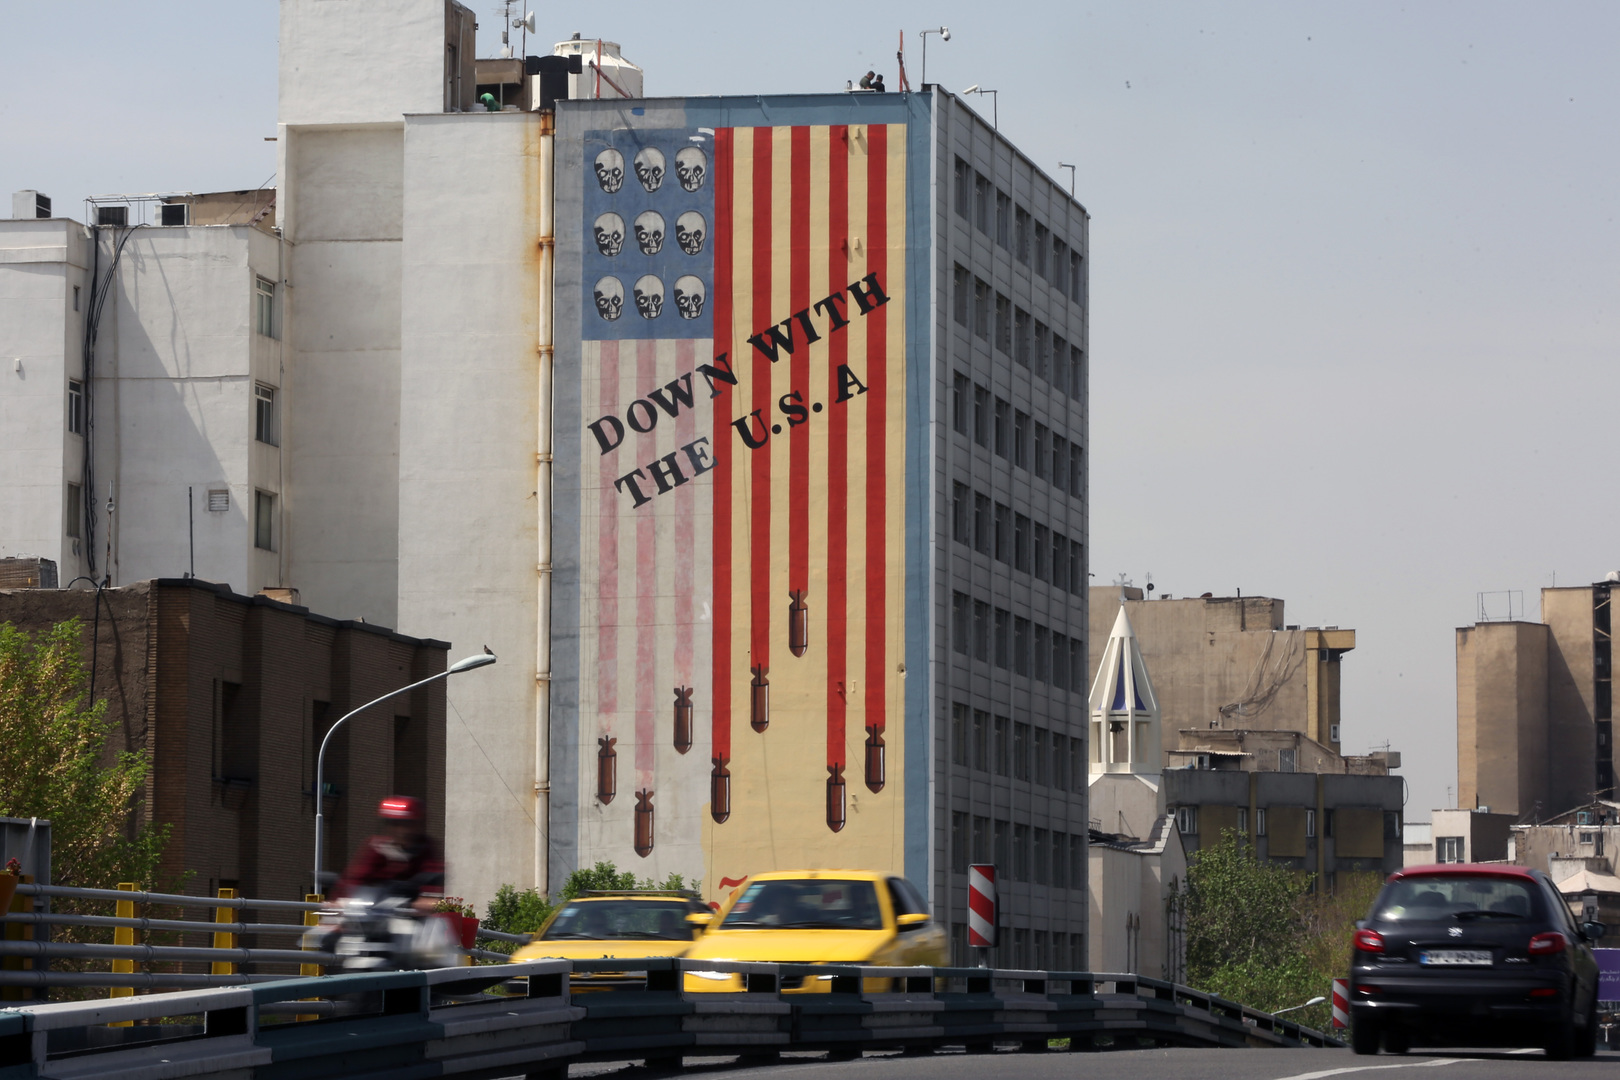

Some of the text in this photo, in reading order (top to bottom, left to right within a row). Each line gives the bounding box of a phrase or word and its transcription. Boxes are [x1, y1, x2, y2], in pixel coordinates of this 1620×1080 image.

[587, 271, 891, 456] DOWN WITH
[613, 436, 719, 509] THE
